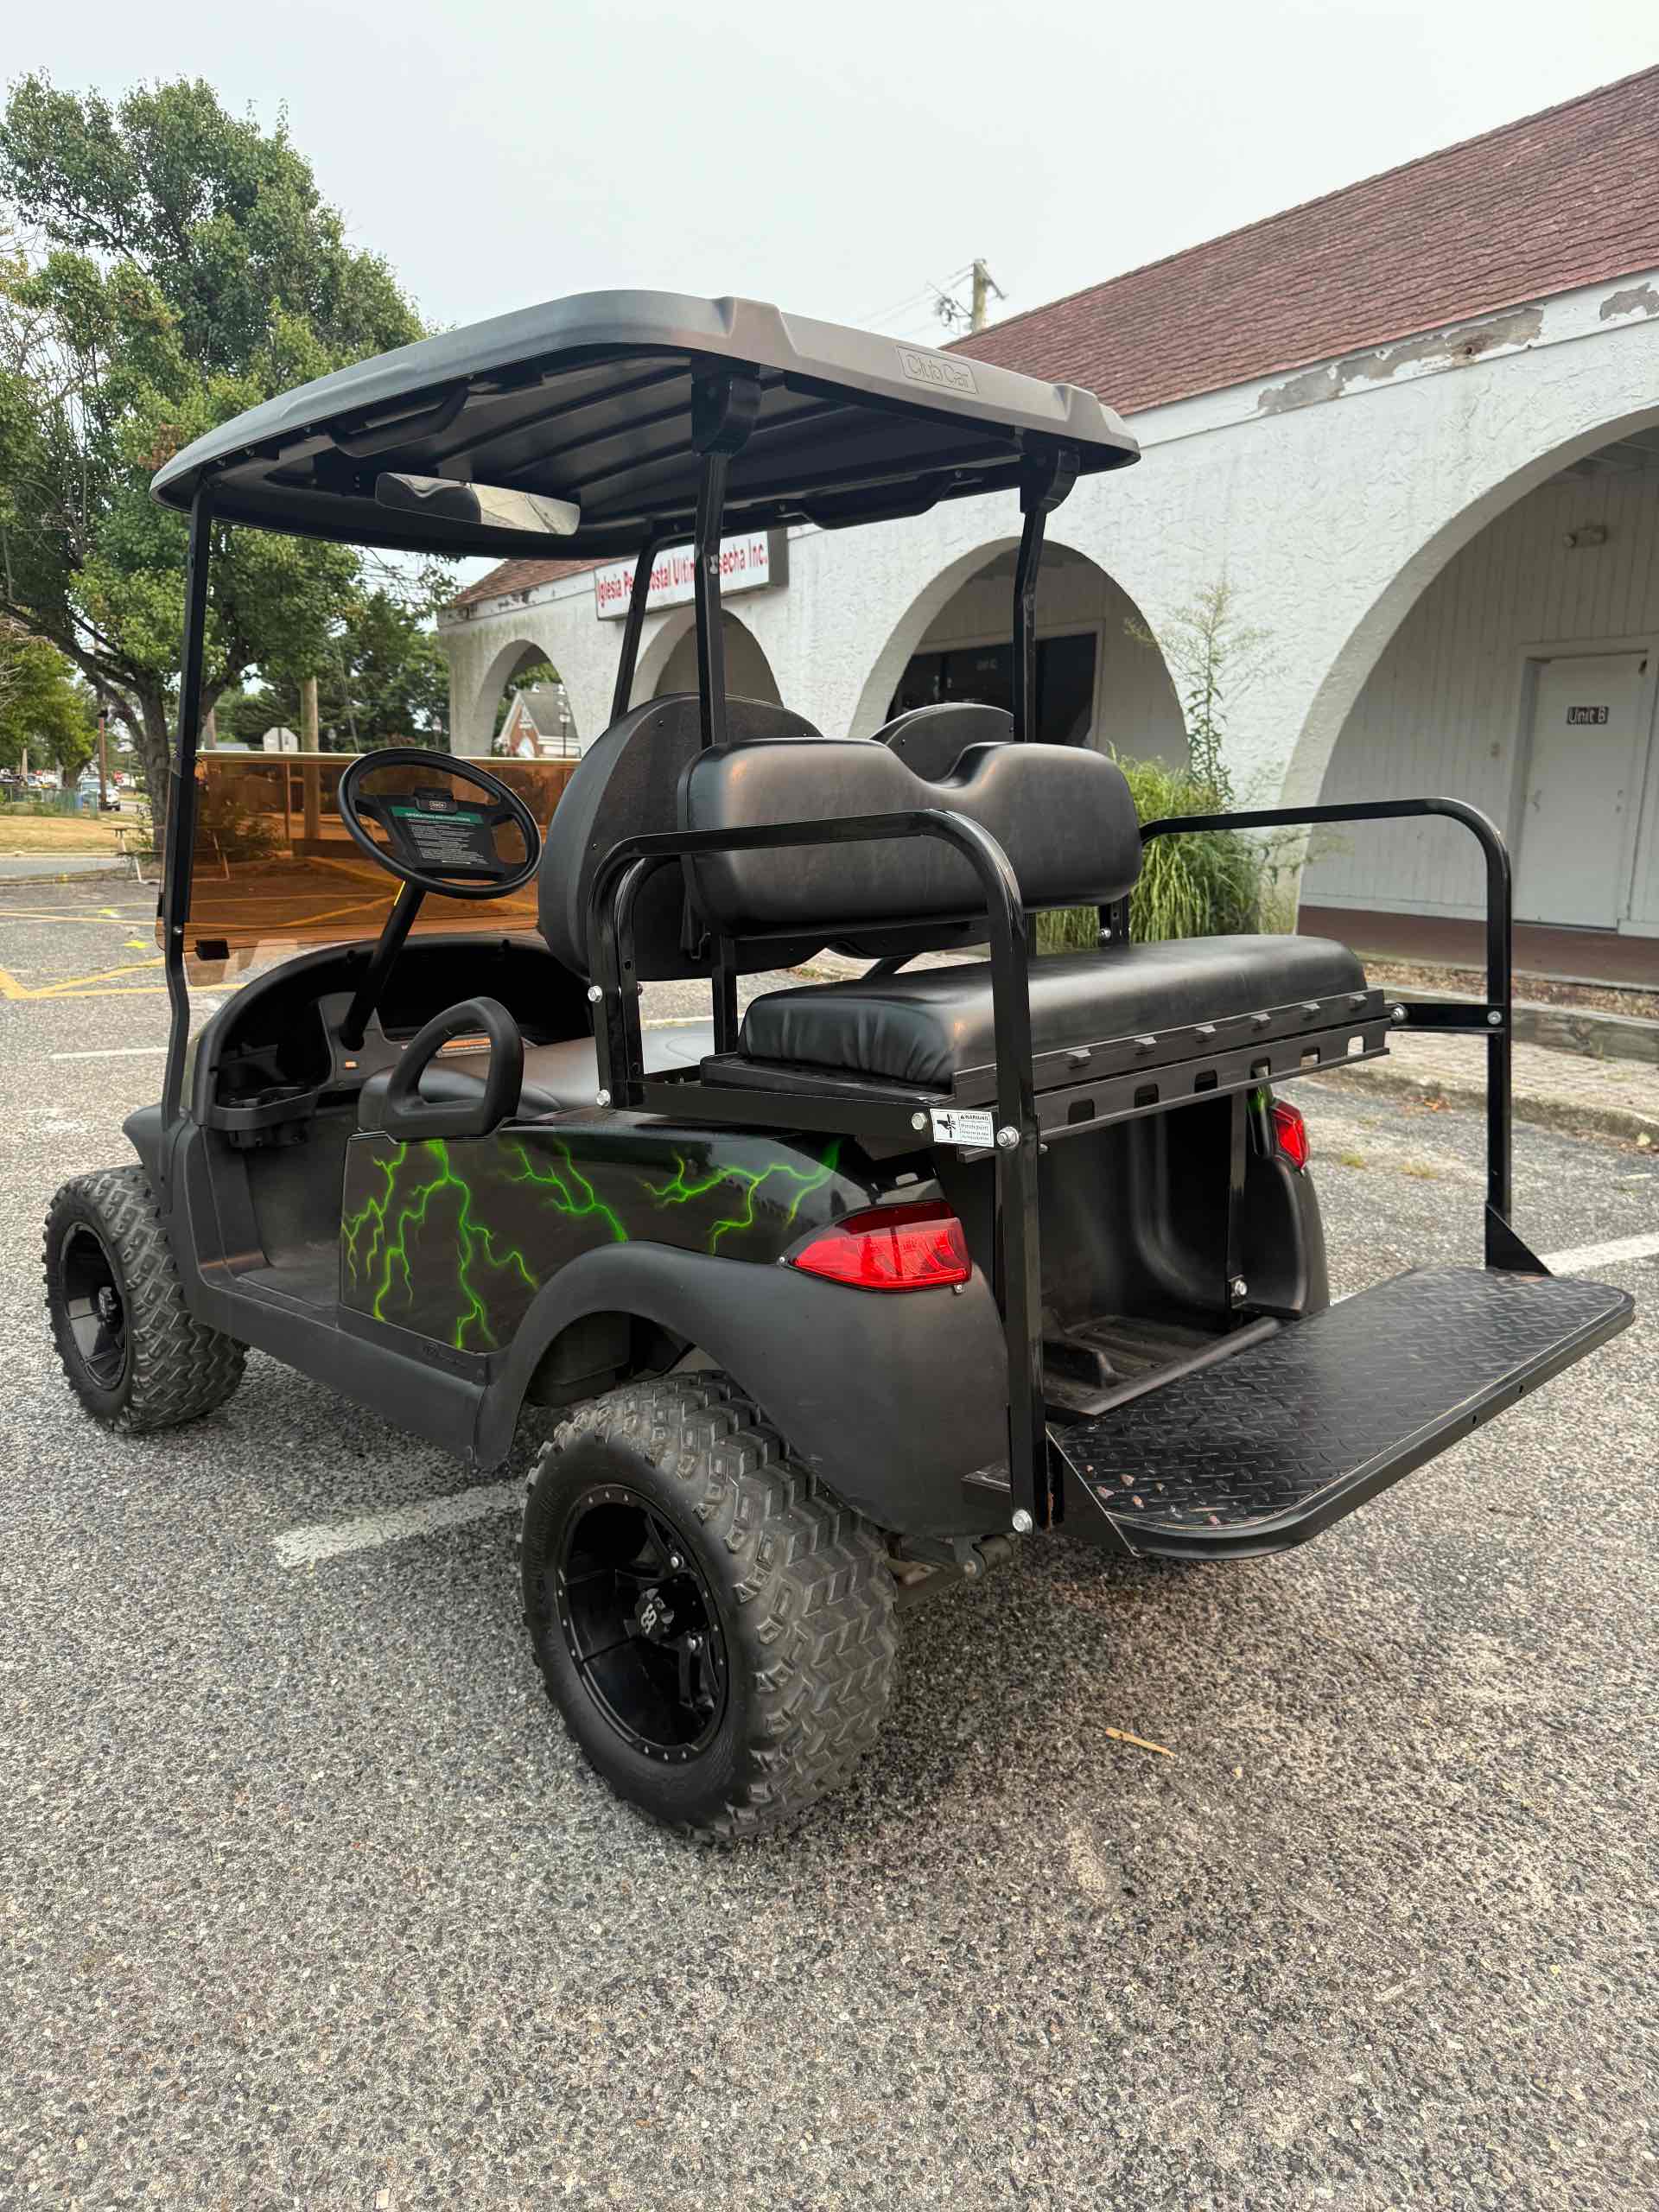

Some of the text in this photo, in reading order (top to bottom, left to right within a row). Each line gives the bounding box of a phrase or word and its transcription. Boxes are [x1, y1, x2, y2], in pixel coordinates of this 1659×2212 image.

[598, 574, 622, 608] Iglesia
[623, 560, 671, 594] Peostal
[1568, 707, 1595, 725] Unit
